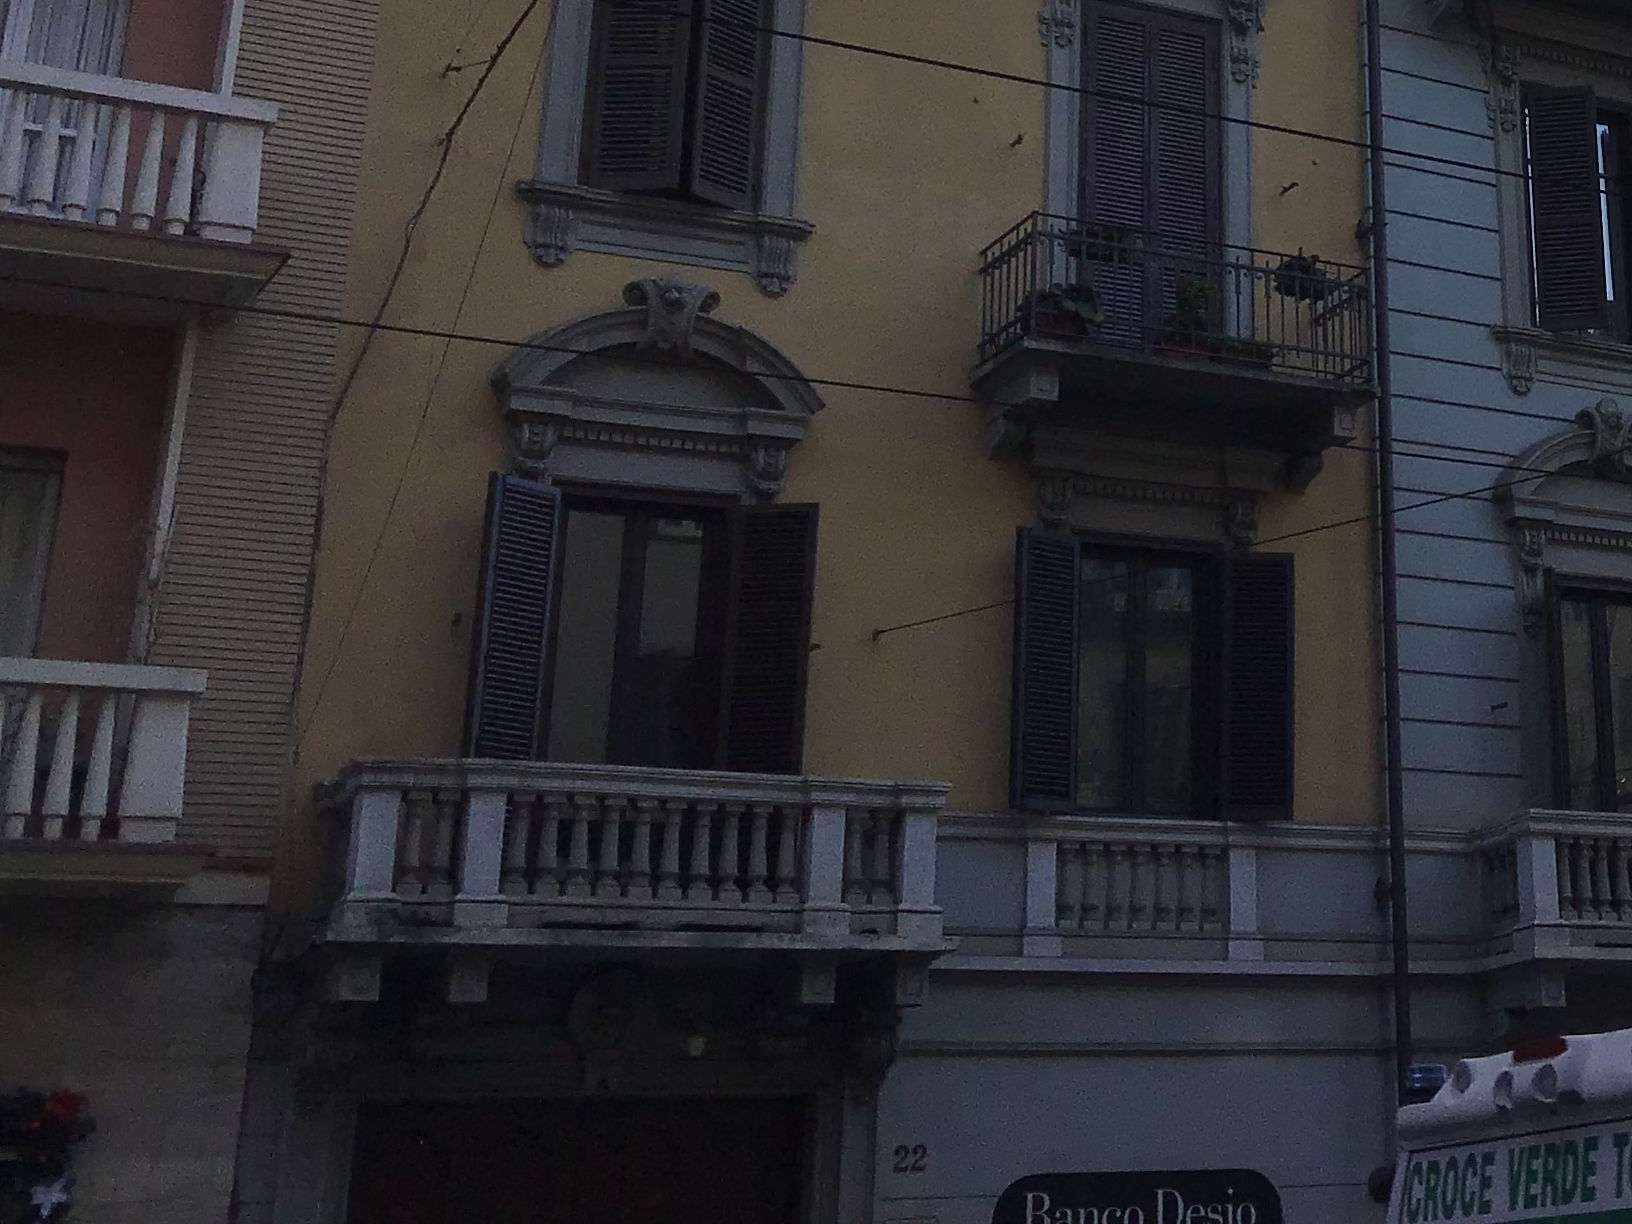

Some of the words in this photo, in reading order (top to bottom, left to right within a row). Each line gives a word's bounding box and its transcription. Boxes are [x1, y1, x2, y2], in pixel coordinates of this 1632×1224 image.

[893, 1144, 927, 1172] 22
[1403, 1152, 1496, 1224] CROCE
[1508, 1136, 1600, 1211] VERDE
[1025, 1192, 1144, 1224] Banco
[1154, 1187, 1257, 1224] Desio
